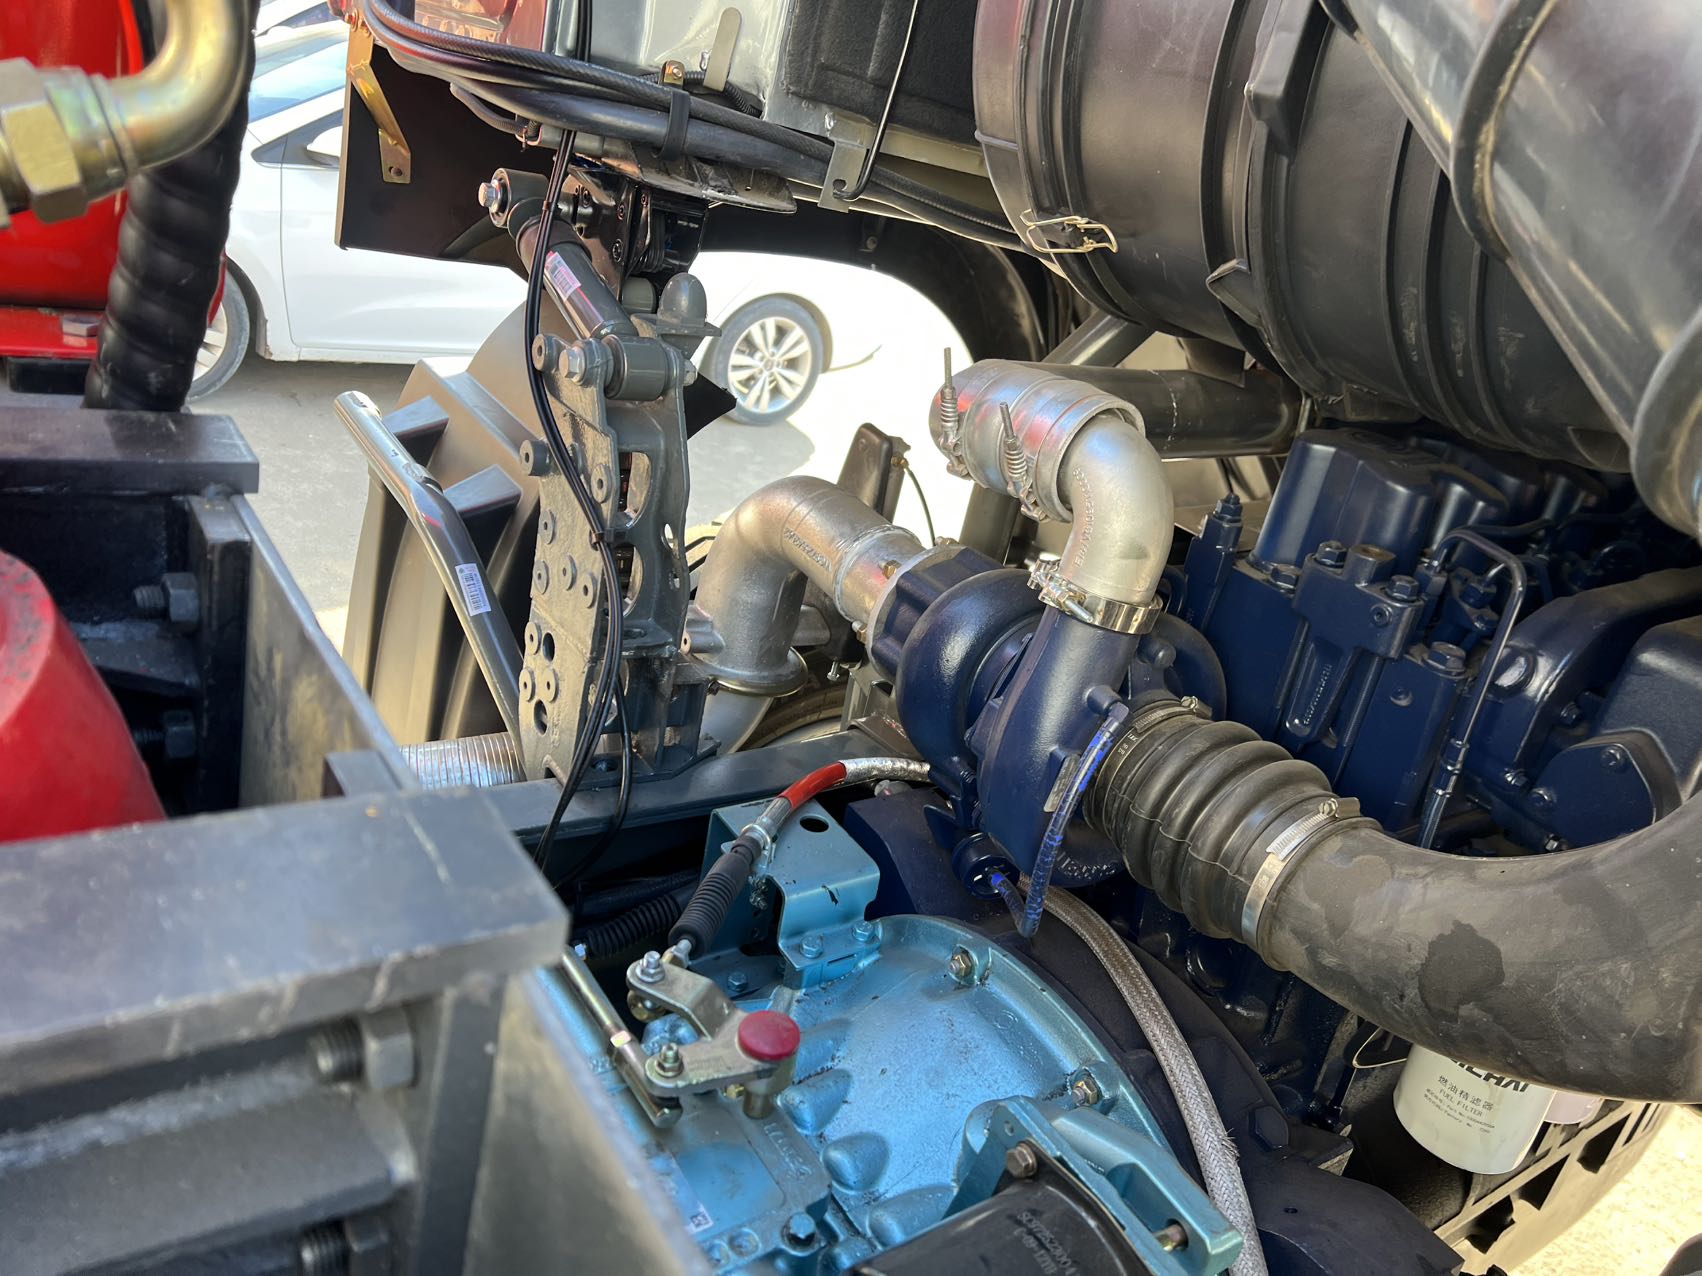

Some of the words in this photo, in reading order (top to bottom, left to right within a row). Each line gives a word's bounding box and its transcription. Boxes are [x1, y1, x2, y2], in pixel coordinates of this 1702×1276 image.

[1438, 1075, 1494, 1111] 燃油精滤器
[1440, 1088, 1454, 1102] FUEL
[1457, 1101, 1483, 1117] FILTER
